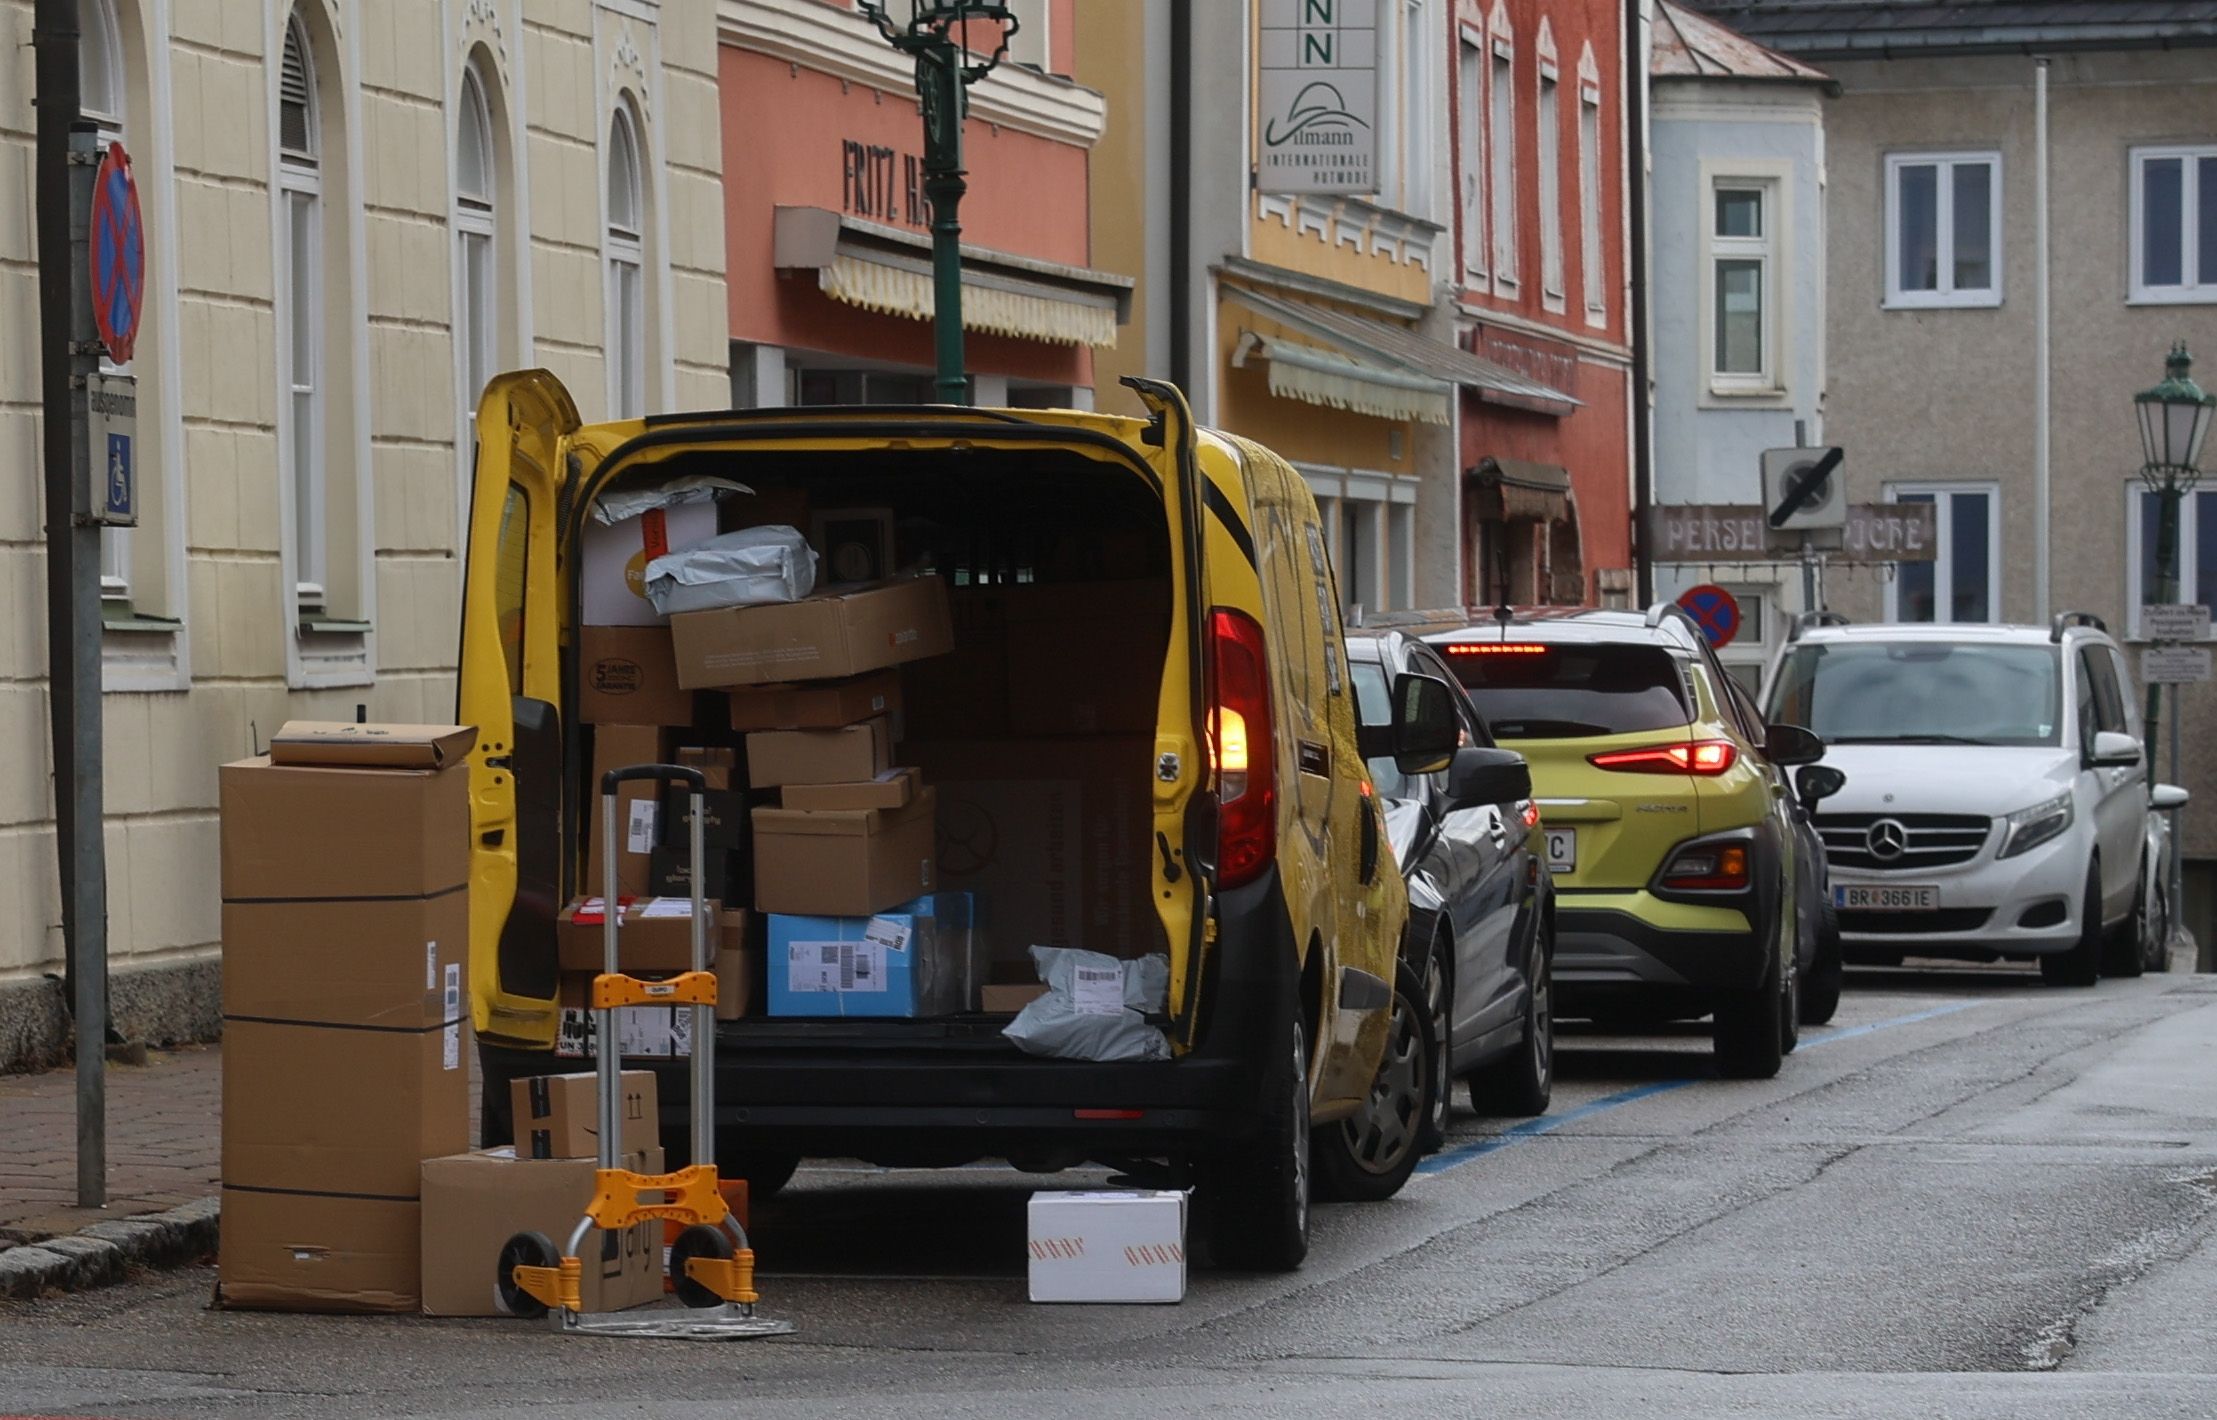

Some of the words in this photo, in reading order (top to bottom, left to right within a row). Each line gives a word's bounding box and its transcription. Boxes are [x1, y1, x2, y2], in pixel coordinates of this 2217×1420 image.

[1266, 153, 1369, 167] INTERNATIONALE
[842, 139, 897, 221] FRITZ
[1313, 171, 1369, 185] HUTMODE
[596, 664, 606, 682] 5
[607, 664, 636, 675] JAHRE
[1849, 890, 1869, 906] BR
[560, 1041, 574, 1050] UN
